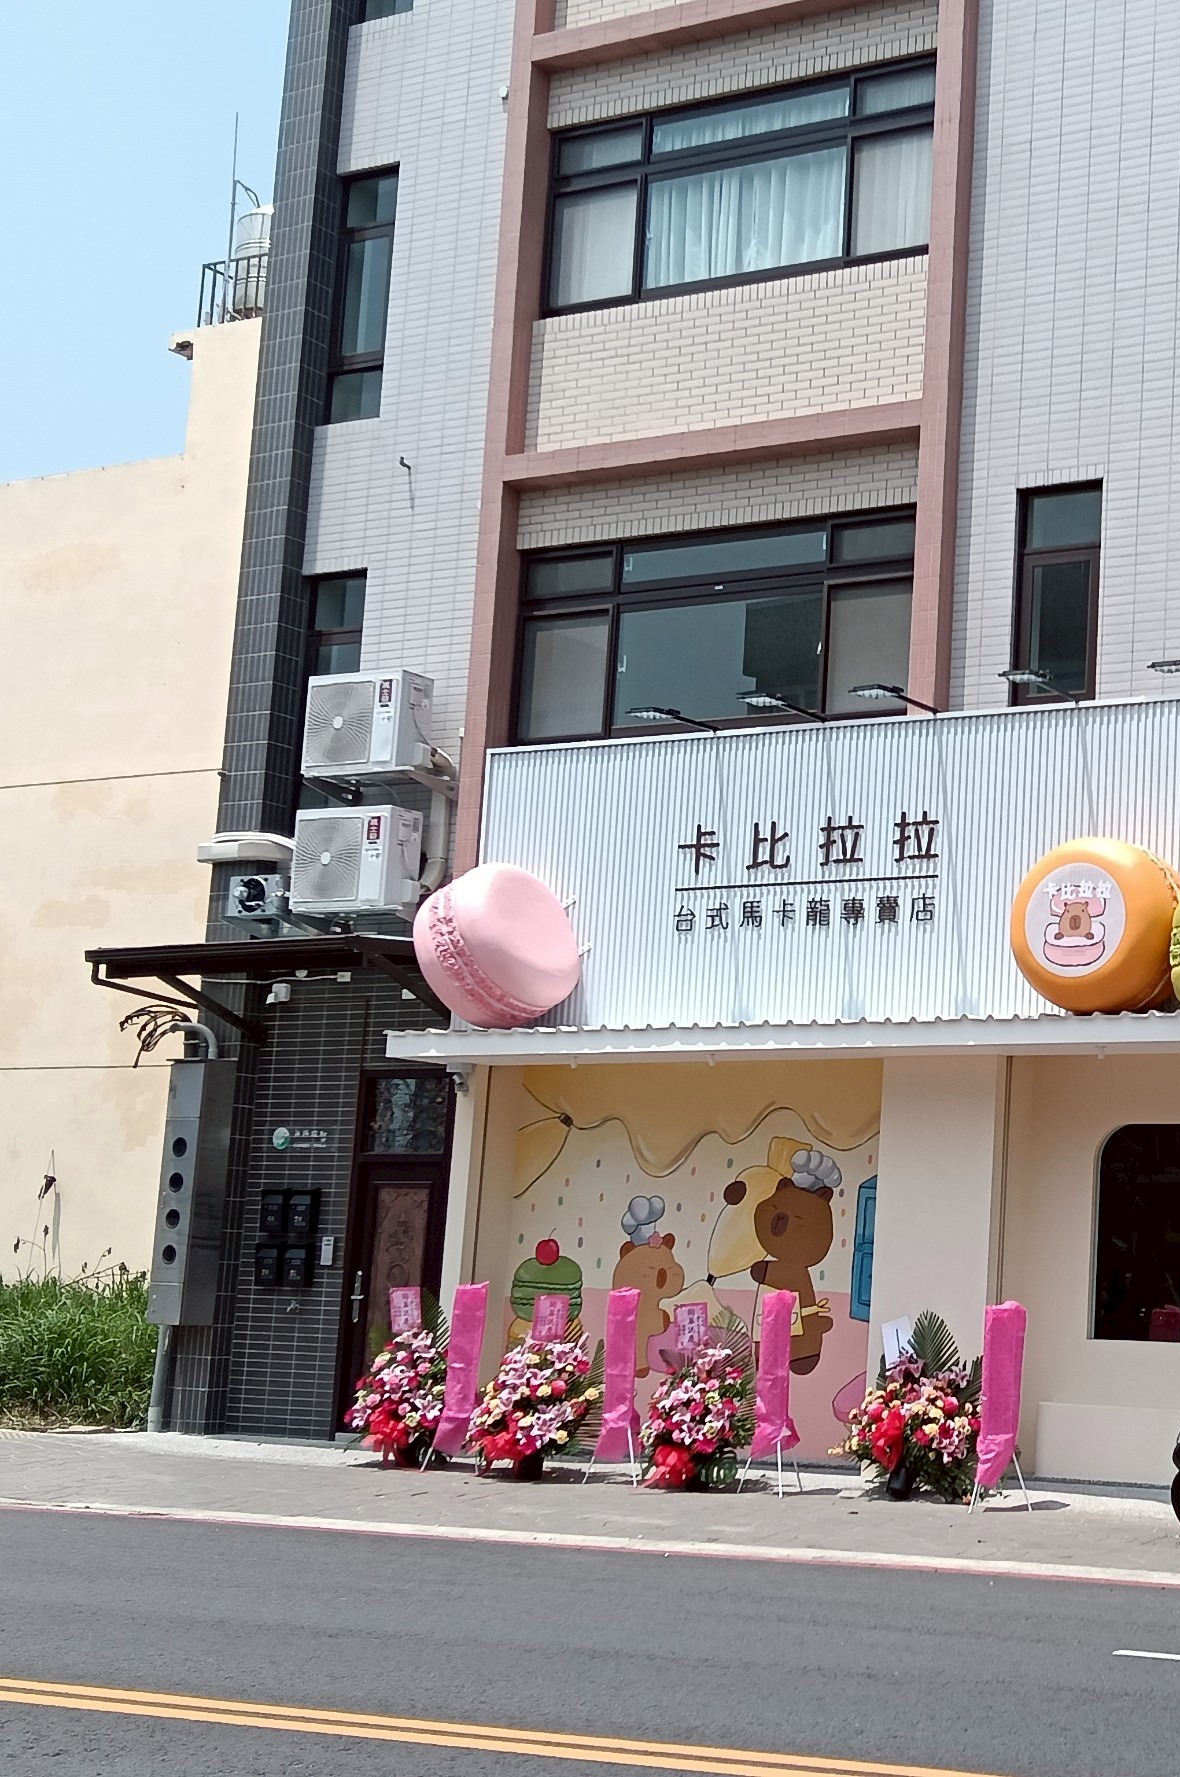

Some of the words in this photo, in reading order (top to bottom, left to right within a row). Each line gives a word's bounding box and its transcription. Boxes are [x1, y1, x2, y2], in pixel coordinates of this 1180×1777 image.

[678, 810, 940, 875] 卡比拉拉
[1042, 878, 1112, 901] 卡比拉拉
[674, 893, 936, 932] 台式馬卡龍專賣店
